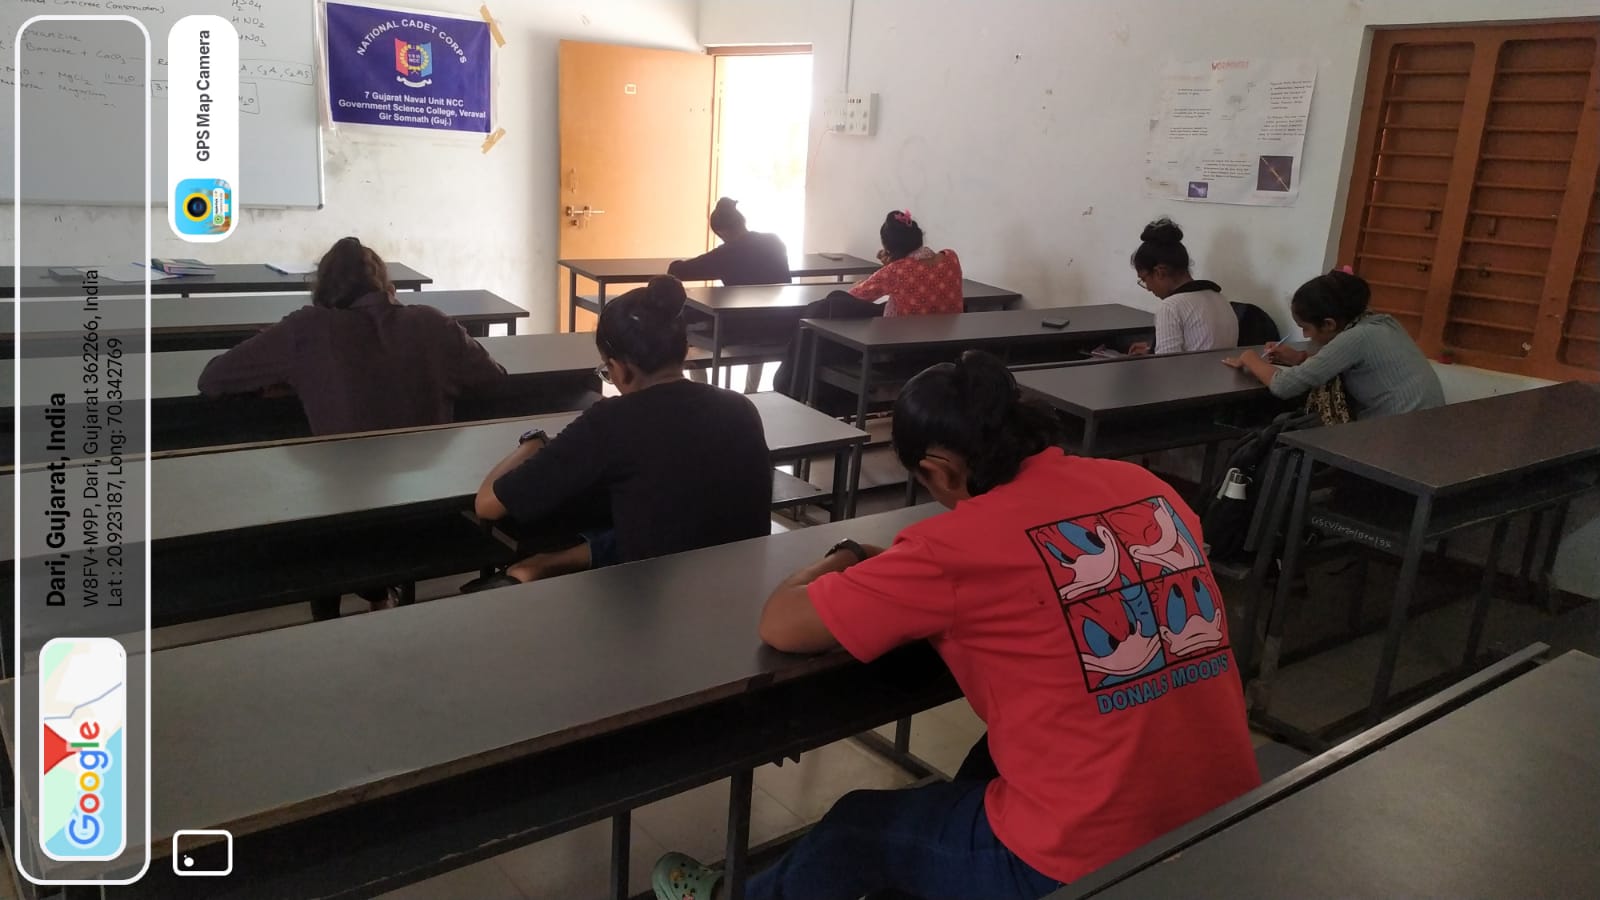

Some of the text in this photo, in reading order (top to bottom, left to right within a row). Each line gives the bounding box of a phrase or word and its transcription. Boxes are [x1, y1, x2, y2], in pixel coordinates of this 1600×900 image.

[357, 19, 467, 64] NATIONAL CADET CORPS
[338, 99, 487, 119] Government Science College, Veraval
[364, 91, 464, 107] 7 Gujarat Naval Unit NCC
[378, 112, 452, 126] Gir Somnath (Guj.)
[1096, 654, 1229, 714] DONALS MOOD'S
